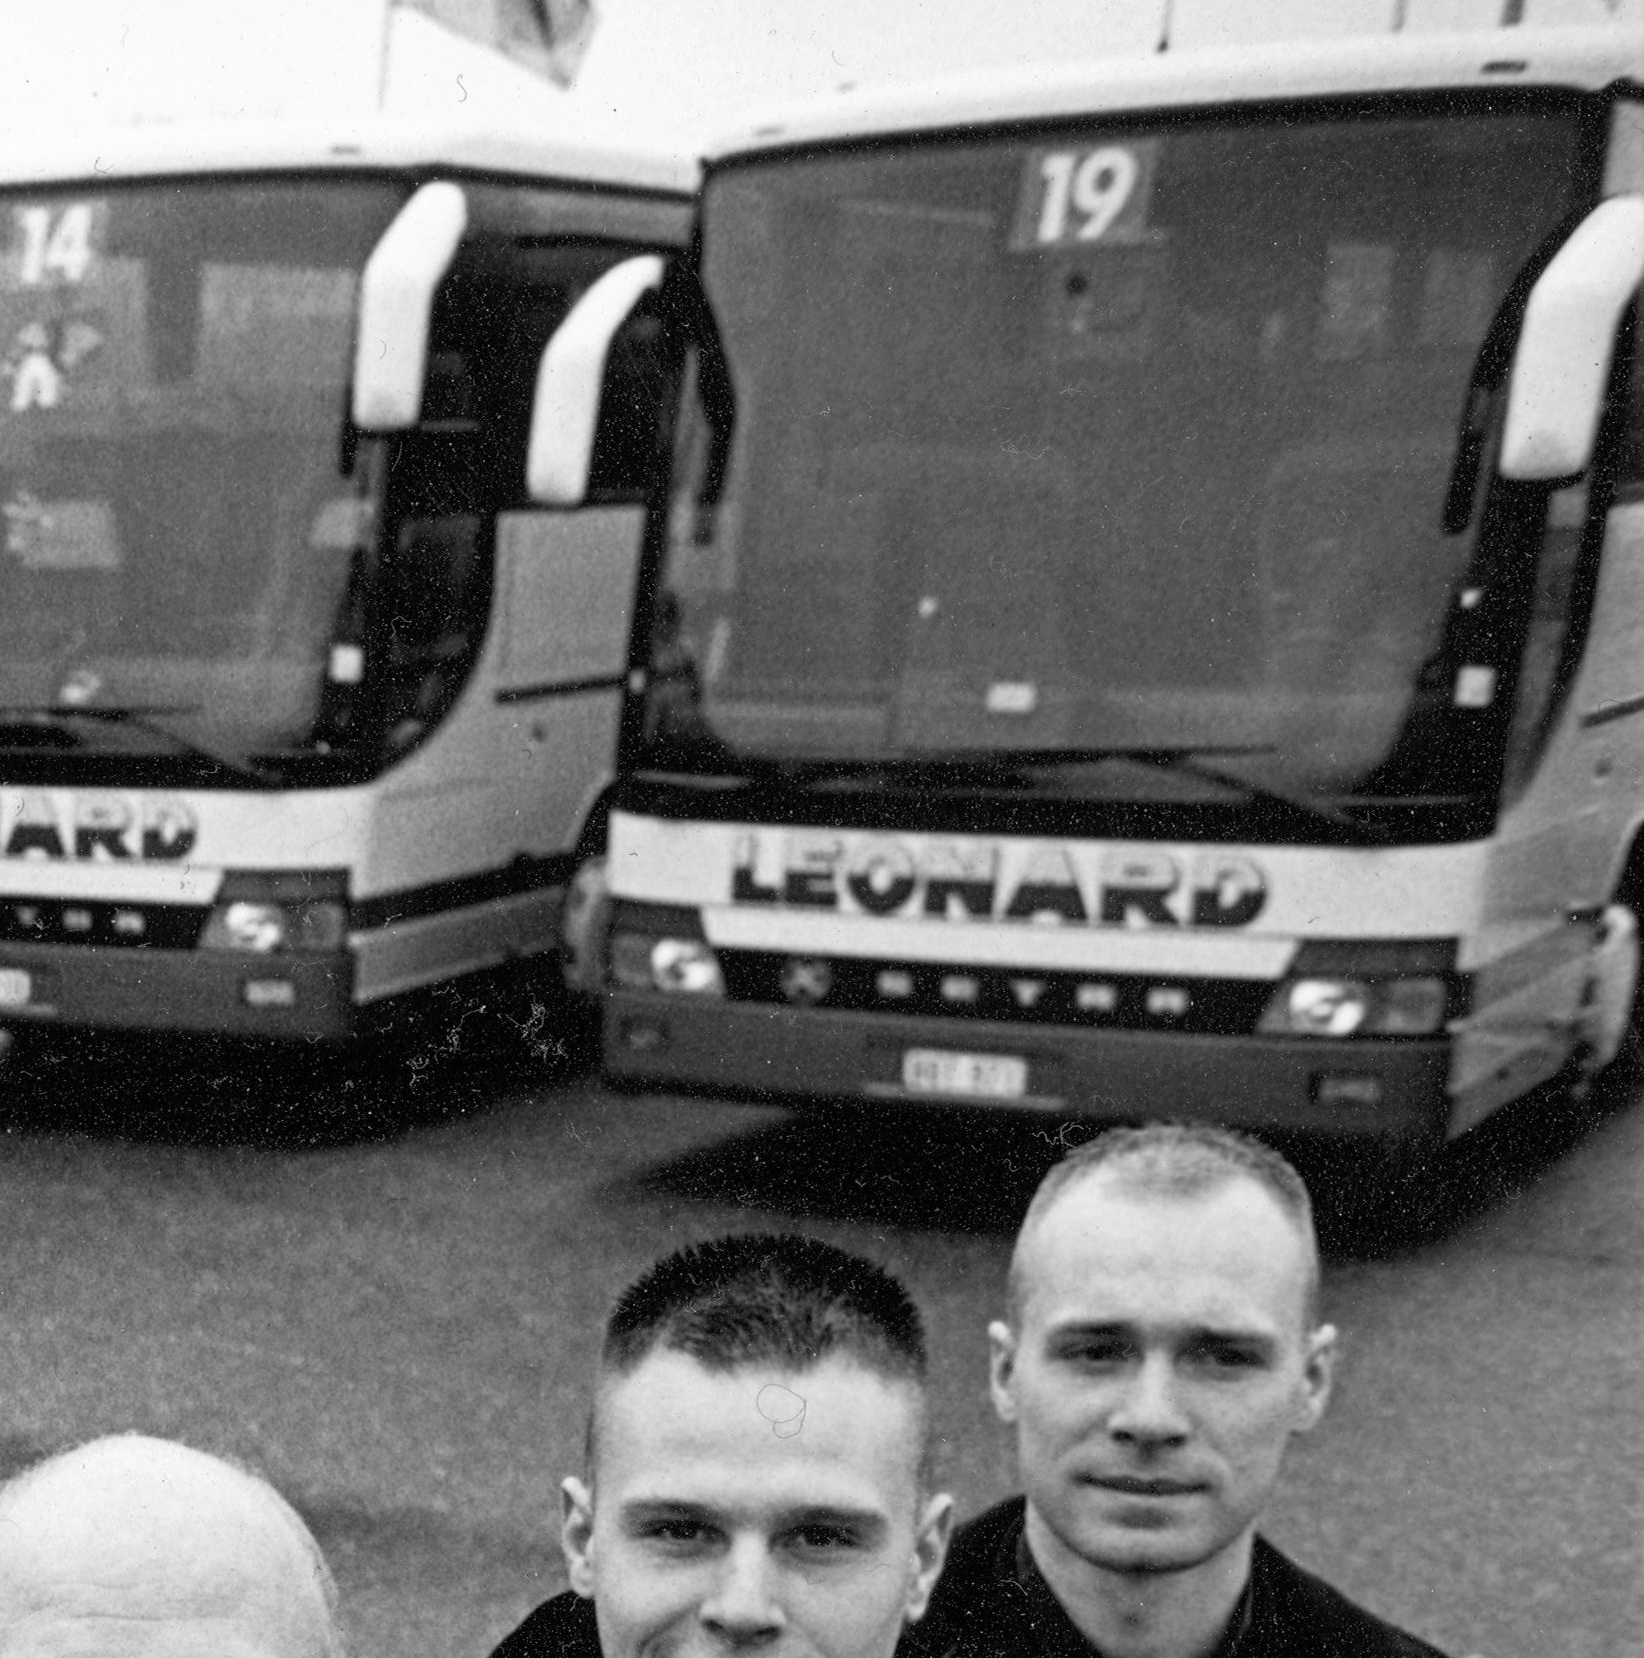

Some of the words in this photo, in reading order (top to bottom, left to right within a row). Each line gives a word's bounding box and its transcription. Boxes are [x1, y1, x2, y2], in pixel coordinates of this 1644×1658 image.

[1038, 148, 1136, 241] 19
[20, 204, 93, 283] 14
[730, 832, 1267, 930] LEONARD
